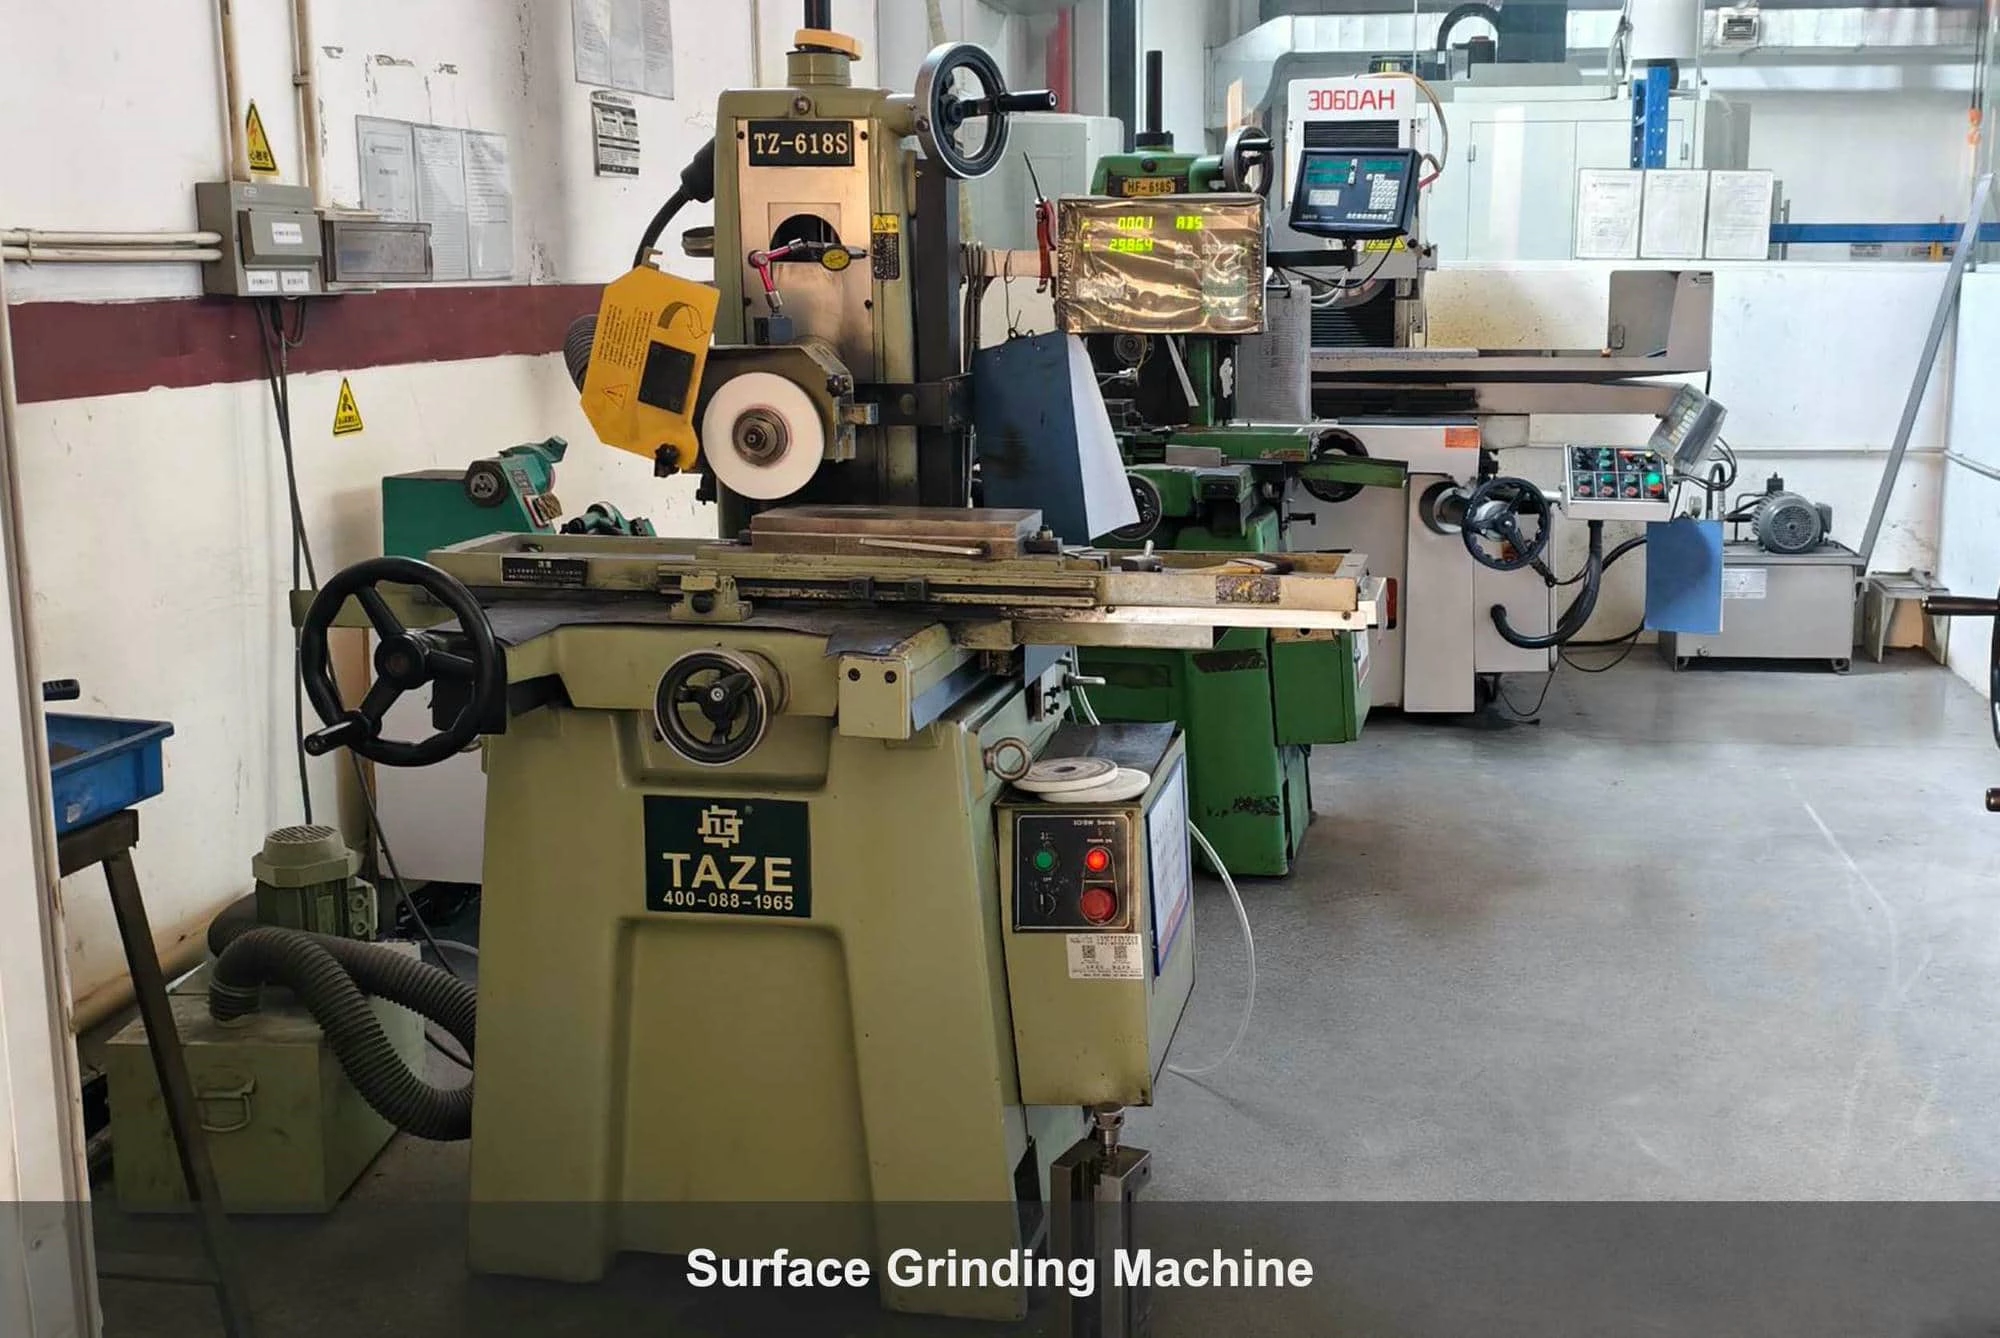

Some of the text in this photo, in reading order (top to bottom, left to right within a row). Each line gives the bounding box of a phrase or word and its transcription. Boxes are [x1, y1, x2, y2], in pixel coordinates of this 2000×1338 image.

[1308, 89, 1396, 111] 3060AH
[753, 132, 848, 154] TZ-618S
[662, 852, 793, 893] TAZE
[663, 890, 794, 911] 400-088-1965
